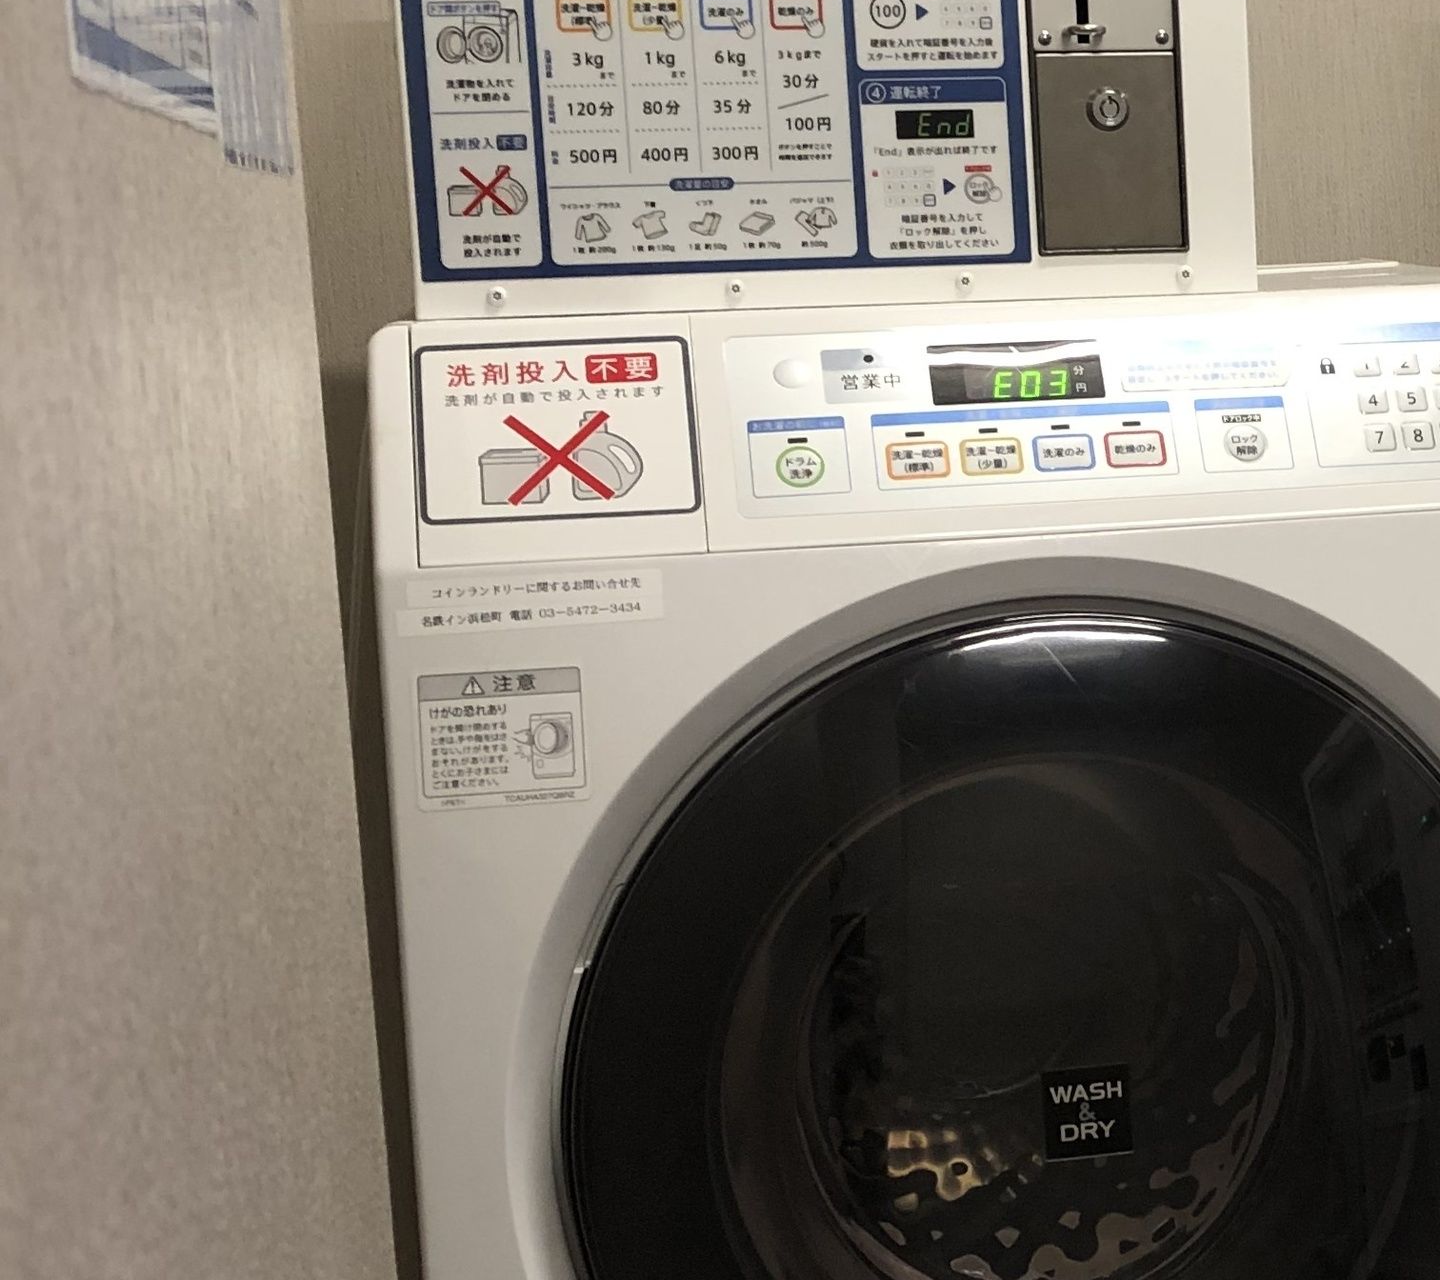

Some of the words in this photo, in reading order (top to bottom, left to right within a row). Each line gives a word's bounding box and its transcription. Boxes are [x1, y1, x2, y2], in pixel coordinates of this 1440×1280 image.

[708, 7, 744, 17] 洗濯のみ
[778, 7, 814, 17] 乾燥のみ
[876, 5, 901, 18] 100
[572, 52, 604, 69] 3kg
[645, 51, 675, 66] 1kg
[715, 50, 746, 65] 6kg
[446, 79, 514, 89] 洗濯物を入れて
[783, 74, 819, 89] 30分
[453, 93, 510, 102] ドアを閉める
[890, 86, 942, 100] 運転終了
[568, 101, 614, 116] 120分
[643, 100, 680, 115] 80分
[714, 100, 751, 114] 35分
[786, 117, 831, 131] 100円
[918, 113, 970, 136] End
[440, 137, 495, 150] 洗剤投入
[569, 149, 617, 164] 500円
[641, 148, 688, 161] 400円
[712, 146, 759, 161] 300円
[901, 213, 982, 223] 暗証番号を入力して
[463, 234, 521, 244] 洗剤が自動で
[464, 248, 521, 258] 投入されます
[446, 361, 578, 387] 洗剤投入
[590, 355, 653, 381] 不要
[1074, 365, 1084, 375] 分
[841, 373, 900, 390] 営業中
[993, 370, 1068, 399] E03
[1076, 383, 1087, 392] 円
[445, 385, 664, 407] 洗剤が自動で投入されます
[1368, 395, 1378, 406] 4
[1407, 393, 1416, 404] 5
[1231, 434, 1258, 444] ロック
[1375, 431, 1384, 444] 7
[1414, 429, 1423, 441] 8
[1043, 447, 1085, 459] 洗濯のみ
[1114, 443, 1156, 455] 乾燥のみ
[1236, 445, 1258, 455] 解除
[785, 457, 816, 467] ドラム
[790, 469, 813, 480] 洗浄
[432, 578, 641, 599] コインランドリーに関するお問い合せ先
[510, 610, 532, 621] 電話
[539, 602, 641, 618] 03-5472-3434
[493, 674, 536, 692] 注意
[429, 704, 507, 719] けがの恐れあり
[1049, 1080, 1122, 1104] WASH
[1079, 1102, 1096, 1120] &
[1060, 1120, 1115, 1142] DRY
